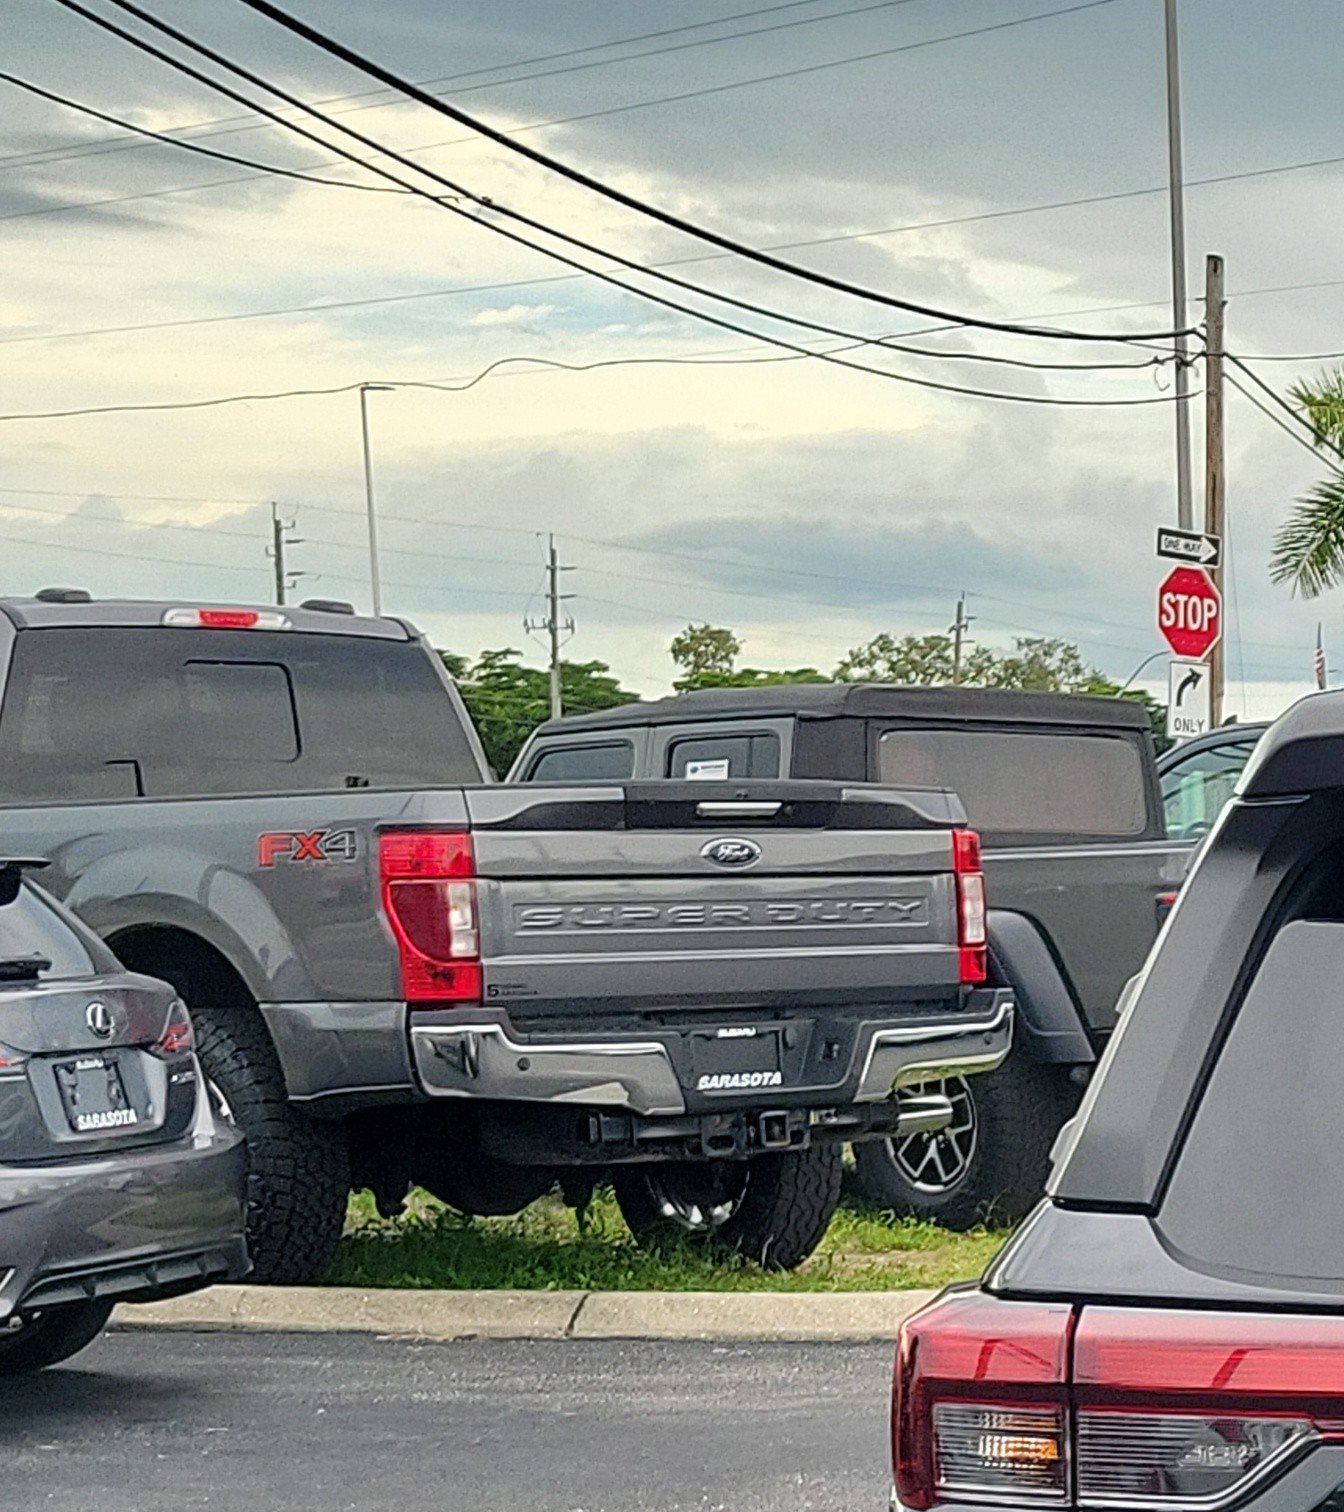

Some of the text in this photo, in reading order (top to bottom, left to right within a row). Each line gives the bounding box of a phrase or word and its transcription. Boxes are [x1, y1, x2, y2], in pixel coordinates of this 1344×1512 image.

[1161, 592, 1217, 632] STOP
[1174, 717, 1205, 733] ONLY
[258, 829, 356, 869] FX4
[521, 900, 922, 928] SUPER DUTY
[696, 1071, 782, 1091] SARASOTA
[76, 1109, 138, 1131] SARASOTA
